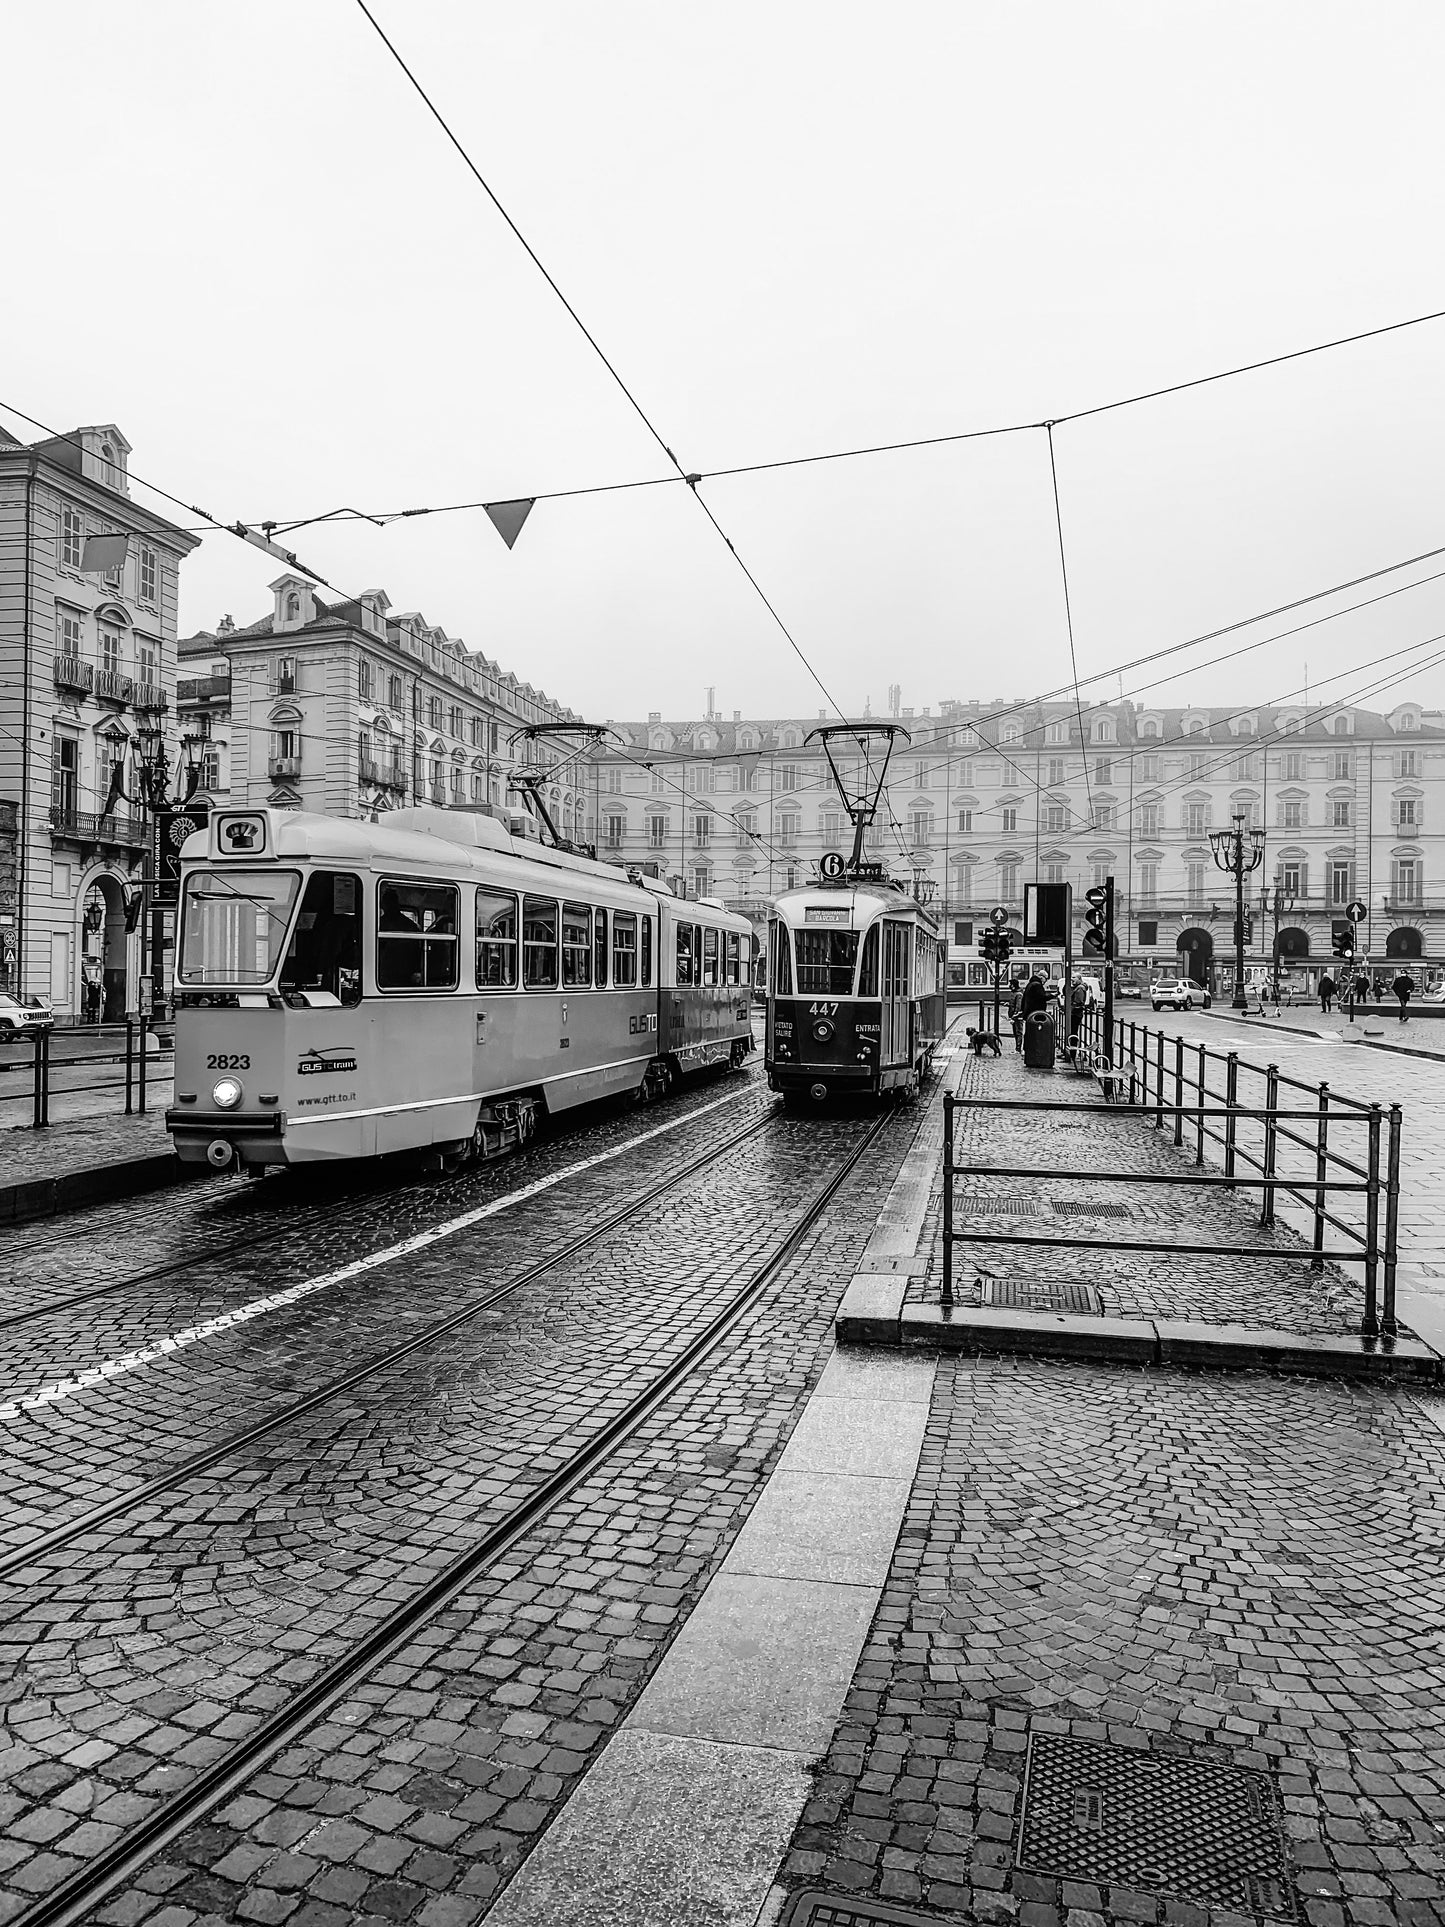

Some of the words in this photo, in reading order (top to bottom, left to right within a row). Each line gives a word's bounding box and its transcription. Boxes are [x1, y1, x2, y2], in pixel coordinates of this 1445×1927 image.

[170, 804, 187, 812] GTT
[824, 855, 840, 876] 6
[154, 889, 160, 898] LA
[809, 1002, 839, 1016] 447
[855, 1024, 880, 1032] ENTRATA
[206, 1054, 251, 1070] 2823
[297, 1092, 357, 1106] www.gtt.to.it
